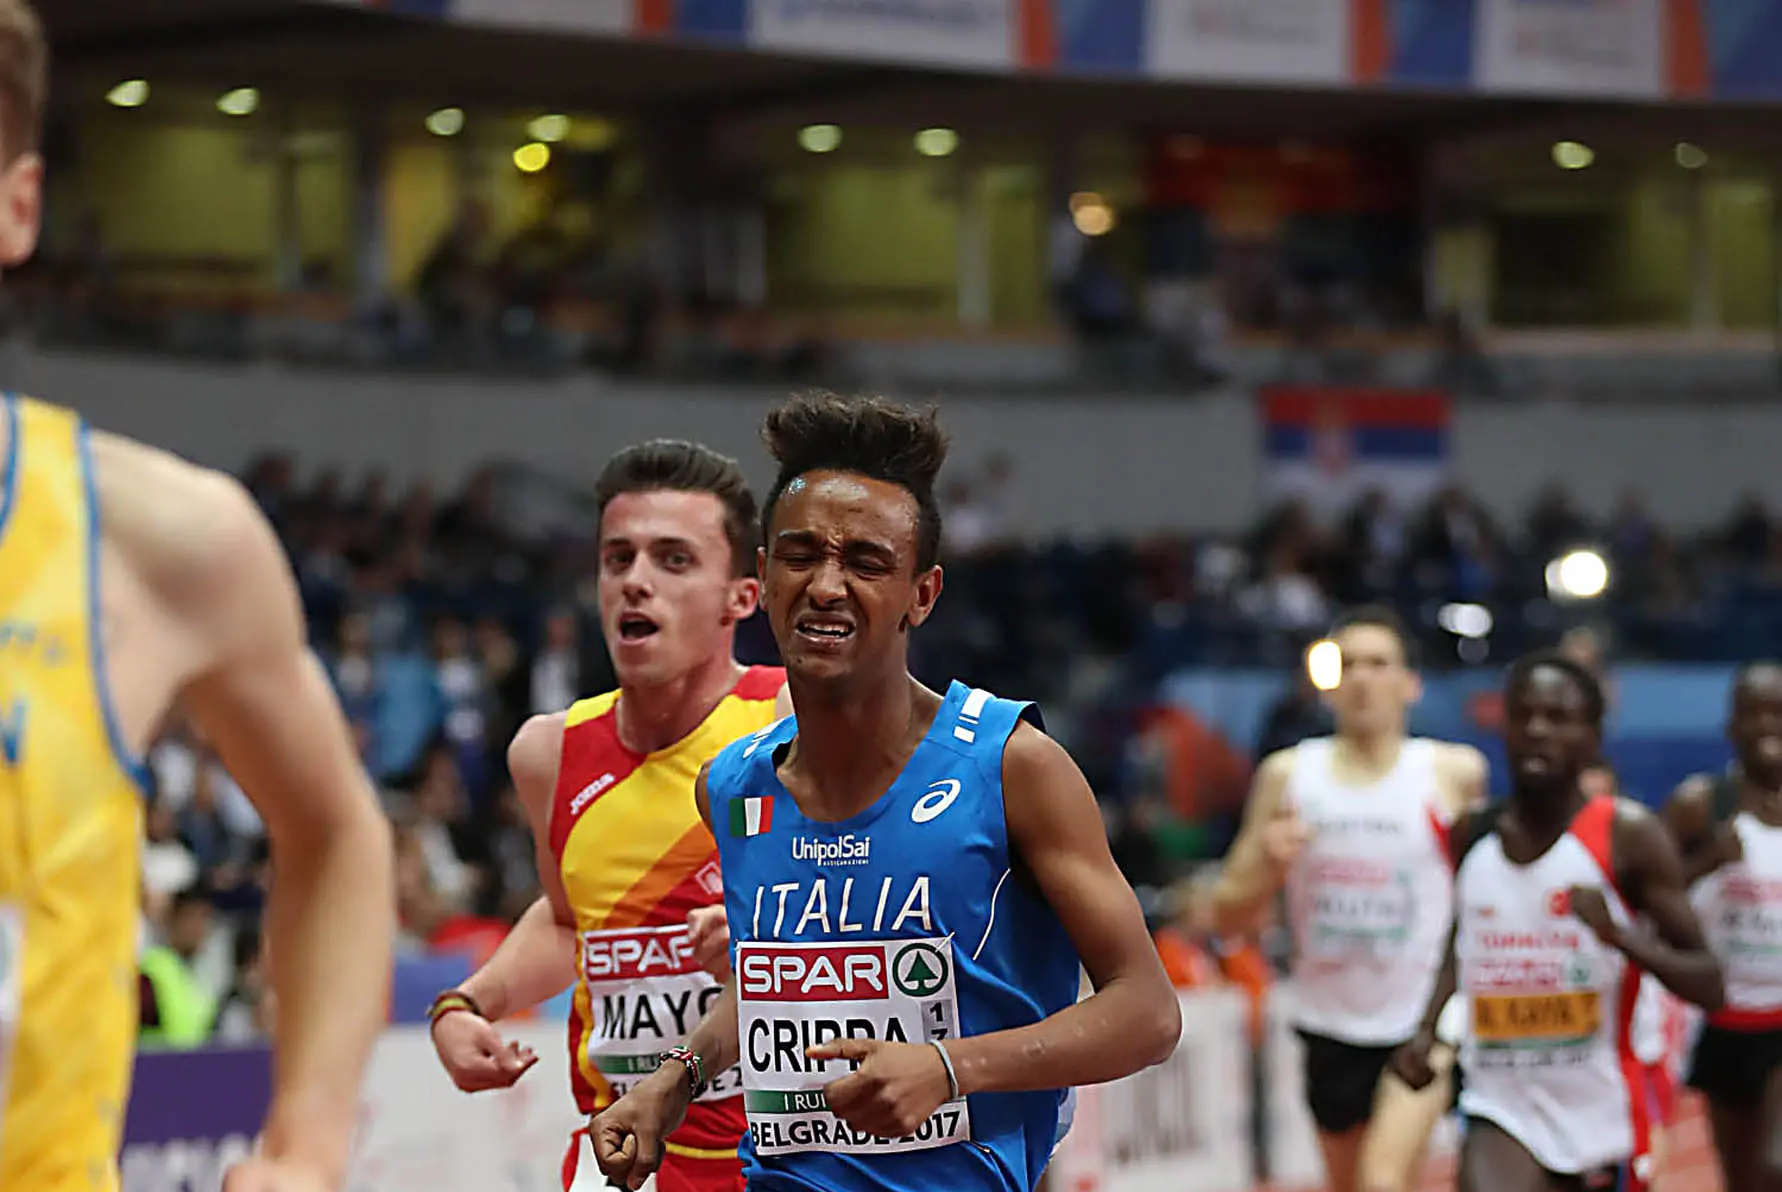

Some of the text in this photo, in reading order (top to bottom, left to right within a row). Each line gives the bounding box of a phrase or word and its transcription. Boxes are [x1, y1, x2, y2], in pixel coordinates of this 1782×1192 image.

[792, 834, 871, 867] UnipolSai
[753, 876, 932, 939] ITALIA
[743, 954, 883, 993] SPAR
[795, 1093, 827, 1111] RU
[899, 1111, 961, 1143] 017
